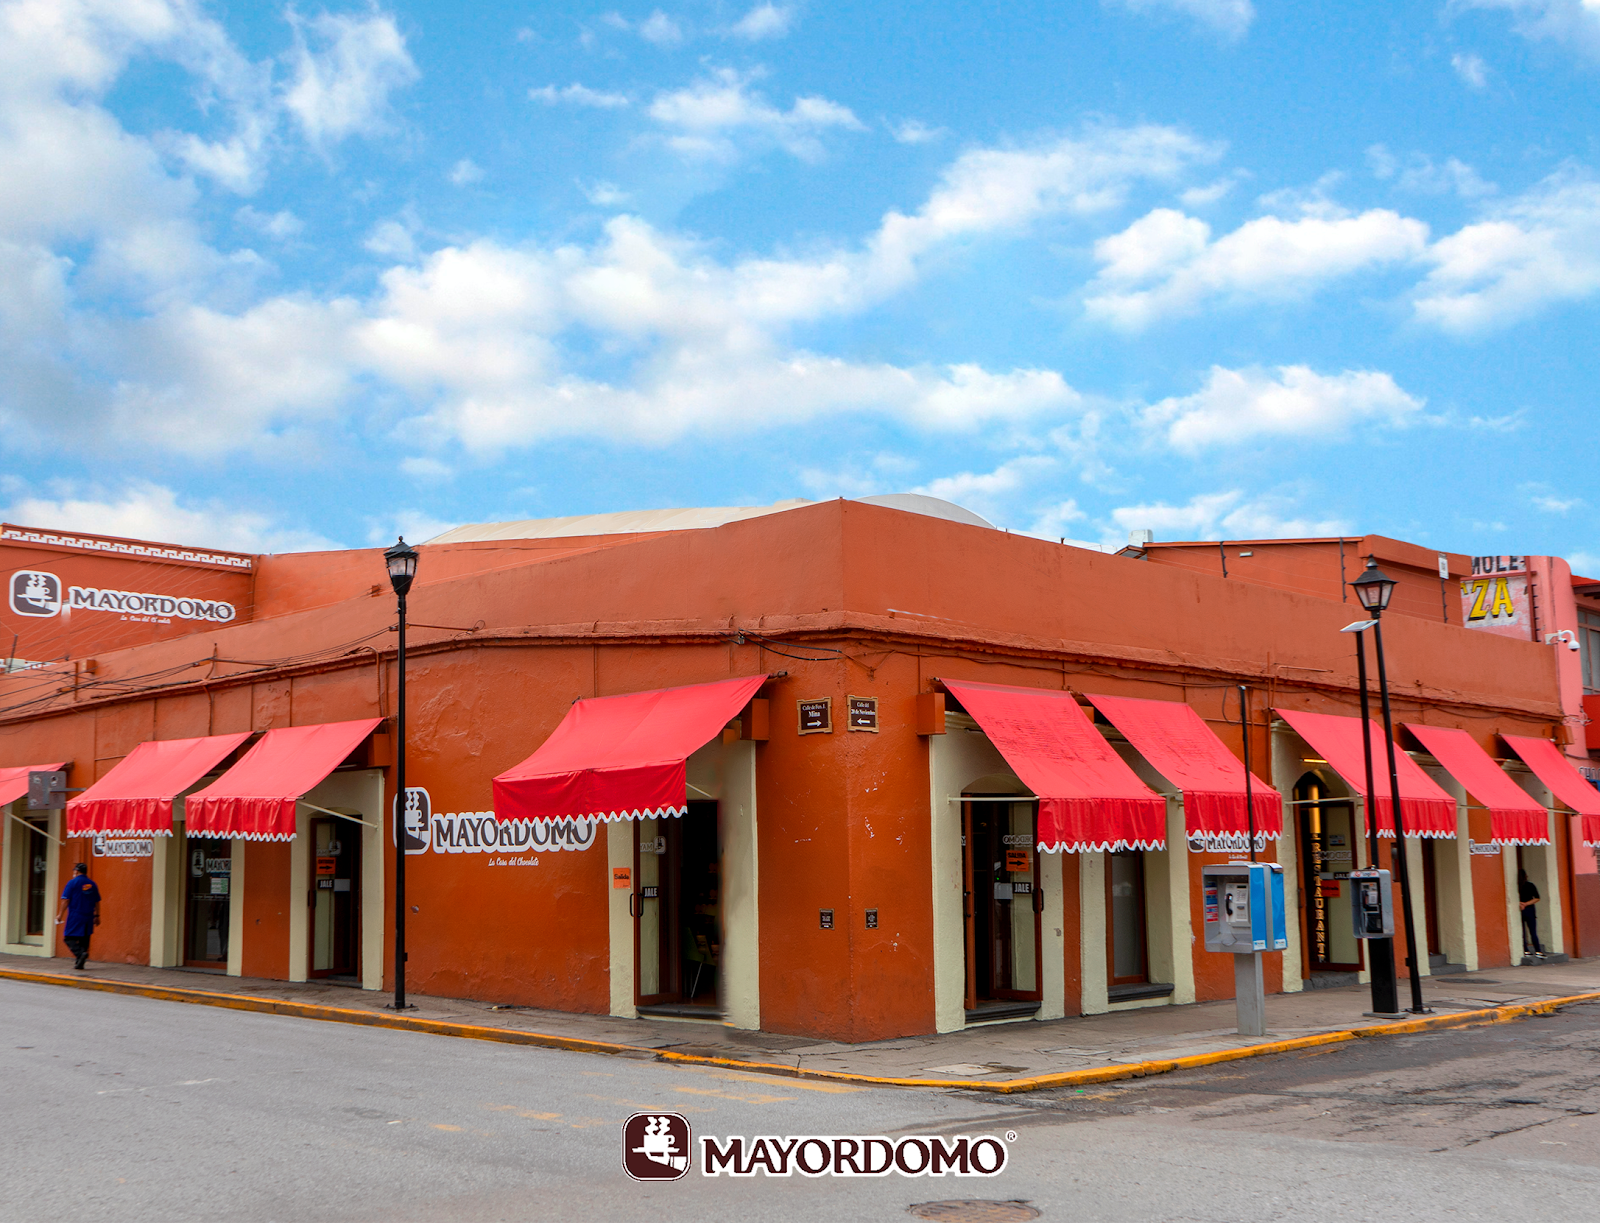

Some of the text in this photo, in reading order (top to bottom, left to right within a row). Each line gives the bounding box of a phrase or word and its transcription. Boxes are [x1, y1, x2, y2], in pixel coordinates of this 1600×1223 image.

[71, 588, 233, 620] MAYORDOMO
[1460, 577, 1515, 621] ZA
[432, 817, 593, 848] MAYORDOMO
[488, 856, 539, 866] La Casa del Chocolate
[1014, 883, 1030, 893] JALE
